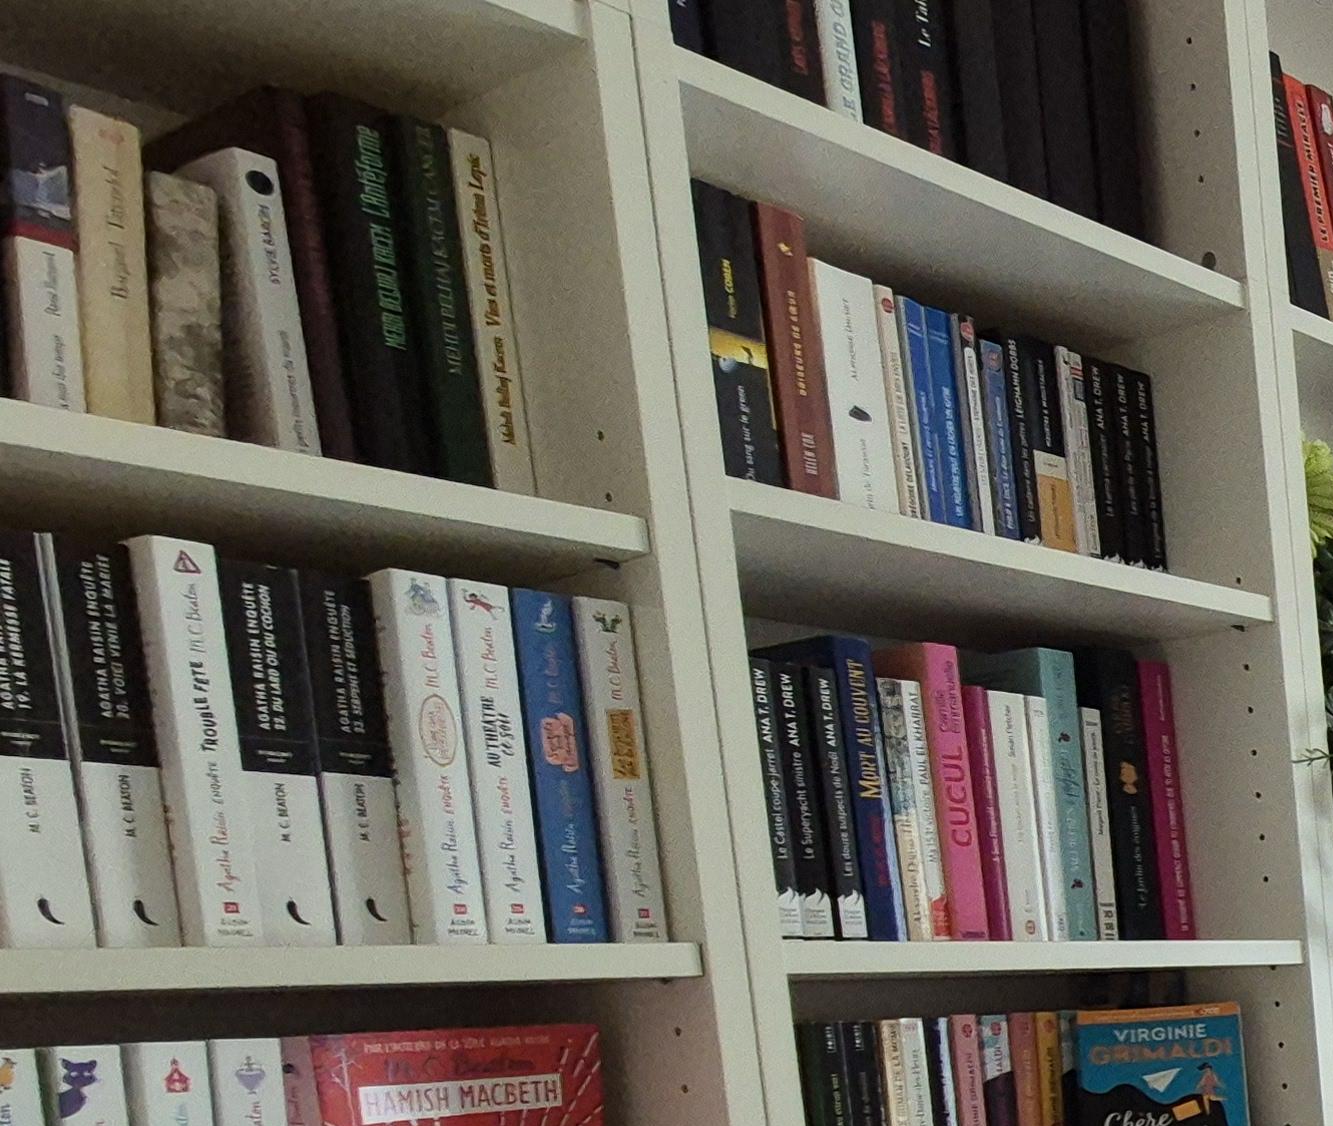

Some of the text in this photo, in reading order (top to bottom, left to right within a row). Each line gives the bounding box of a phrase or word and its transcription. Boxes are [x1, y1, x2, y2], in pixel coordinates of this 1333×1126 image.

[1296, 101, 1329, 242] LE PREMIER MIRACLE
[102, 602, 117, 619] LA
[79, 560, 112, 718] AGATHA RAISIN ENQUÊTE
[241, 581, 272, 731] AGATHA RAISIN ENQUÊTE
[257, 584, 285, 713] DU LARD OU DU COCHON
[420, 622, 438, 660] Beaton
[479, 626, 495, 661] Beaton
[604, 639, 620, 675] Beaton
[328, 644, 346, 685] RAISIN
[334, 687, 352, 733] AGATHA
[752, 668, 773, 743] ANA DREW
[779, 673, 800, 747] ANA DREW
[818, 678, 837, 747] ANA DREW
[846, 658, 869, 724] COUVENT
[193, 696, 220, 752] TROUBLE
[854, 728, 873, 747] AU
[486, 752, 502, 768] AU
[858, 752, 882, 798] MORT
[19, 767, 38, 807] BEATON
[118, 774, 137, 812] BEATON
[274, 782, 290, 818] BEATON
[941, 745, 973, 847] CUCUL
[797, 789, 814, 845] Superyacht
[213, 850, 242, 894] Agatha
[440, 818, 468, 896] Agatha Raisin
[497, 818, 525, 893] Agatha Raisin
[777, 846, 787, 860] Le
[805, 847, 815, 860] Le
[1090, 1038, 1233, 1065] GRIMALDI
[1113, 1023, 1208, 1043] VIRGINIE
[363, 1079, 559, 1118] HAMISH MACBETH
